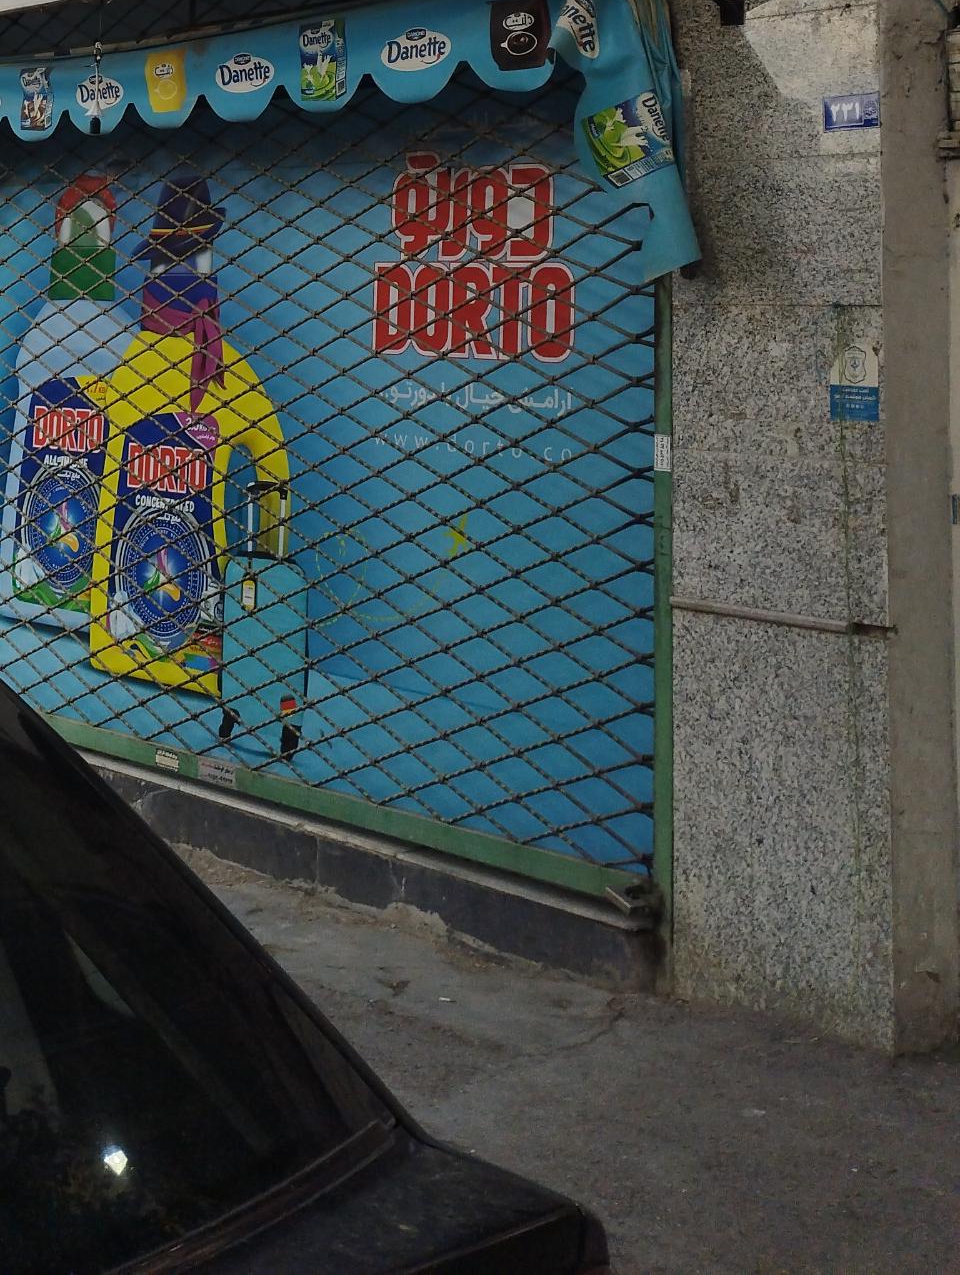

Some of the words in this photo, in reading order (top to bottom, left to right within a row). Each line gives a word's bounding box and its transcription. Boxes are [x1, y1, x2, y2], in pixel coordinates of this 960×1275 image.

[561, 5, 596, 54] nette
[386, 36, 447, 64] Danette
[77, 82, 121, 104] Danette
[218, 61, 271, 87] Danette
[830, 101, 860, 124] ۲۳۱
[373, 261, 576, 363] DORTO
[33, 406, 105, 454] DORTO
[127, 443, 208, 494] DORTO
